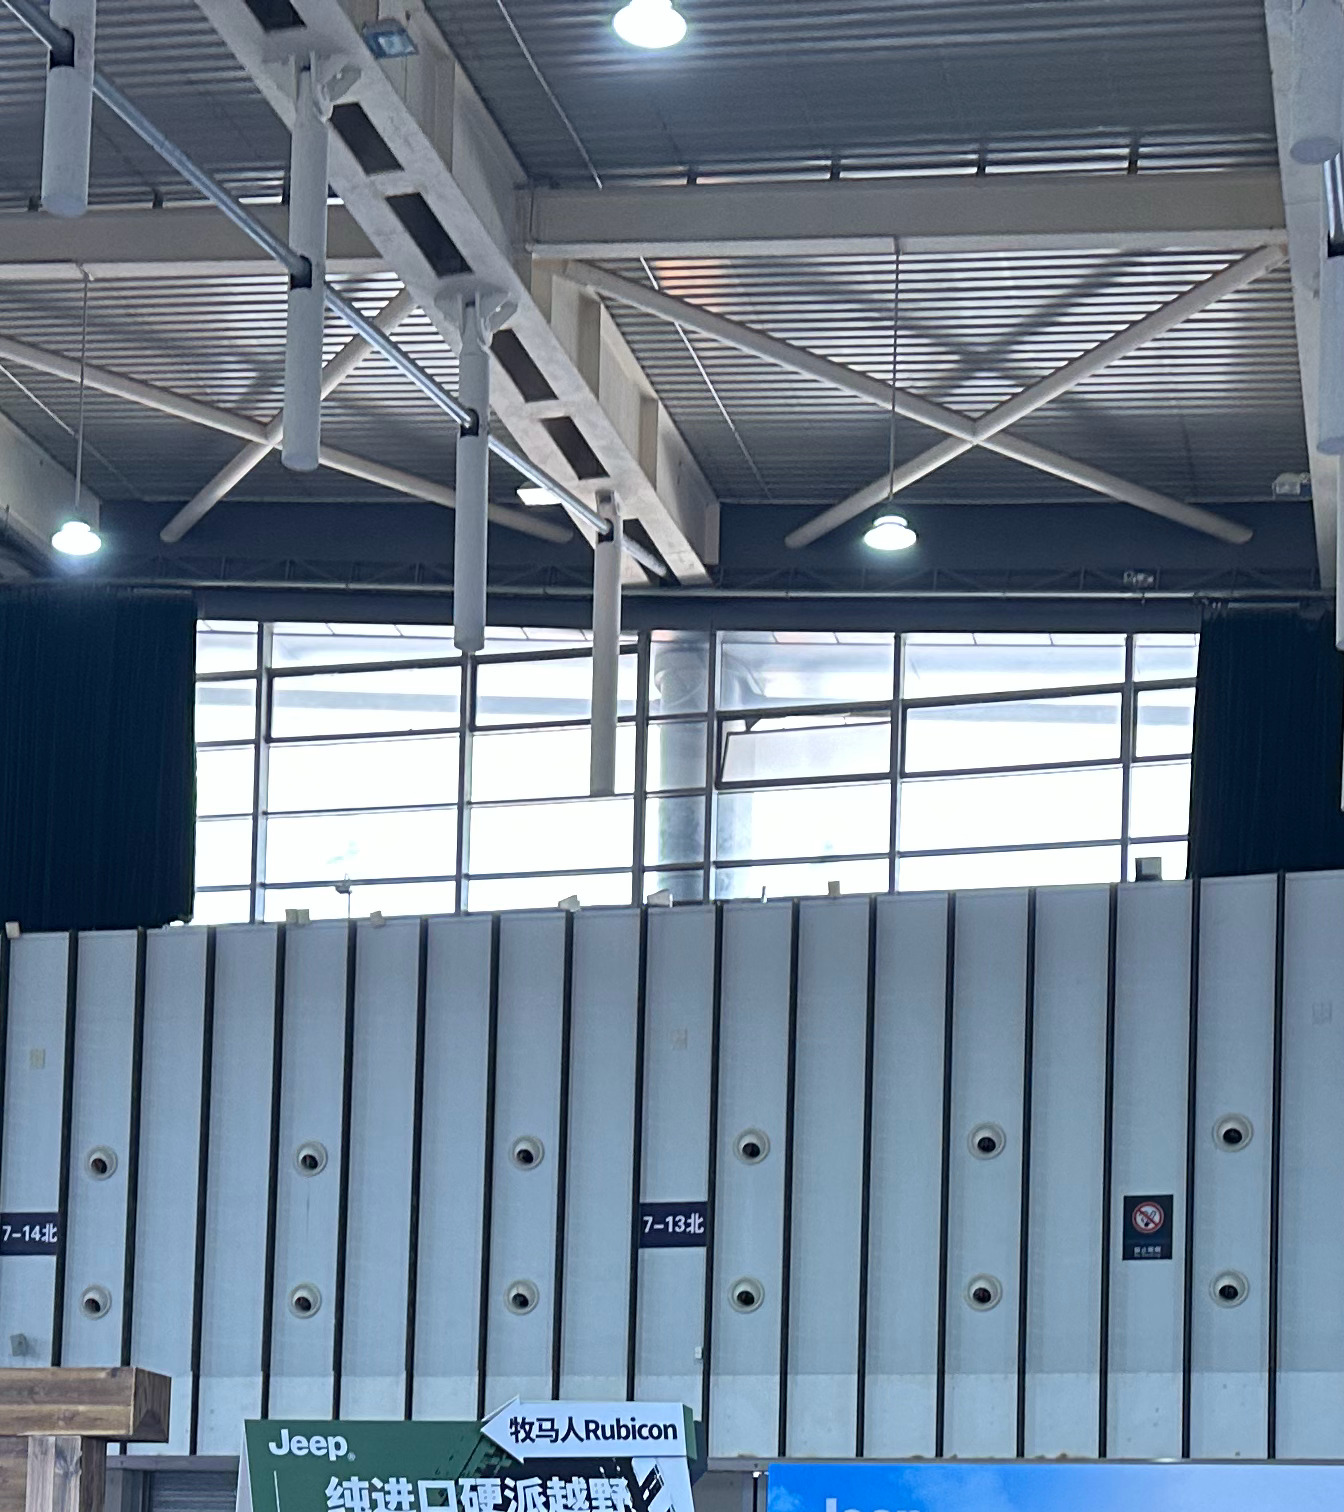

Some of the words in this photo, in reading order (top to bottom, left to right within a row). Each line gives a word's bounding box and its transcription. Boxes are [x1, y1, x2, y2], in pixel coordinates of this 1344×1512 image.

[2, 1222, 58, 1243] 7-14北
[643, 1212, 705, 1234] 7-13北
[509, 1416, 678, 1443] 牧马人Rubicon
[268, 1428, 348, 1461] Jeep
